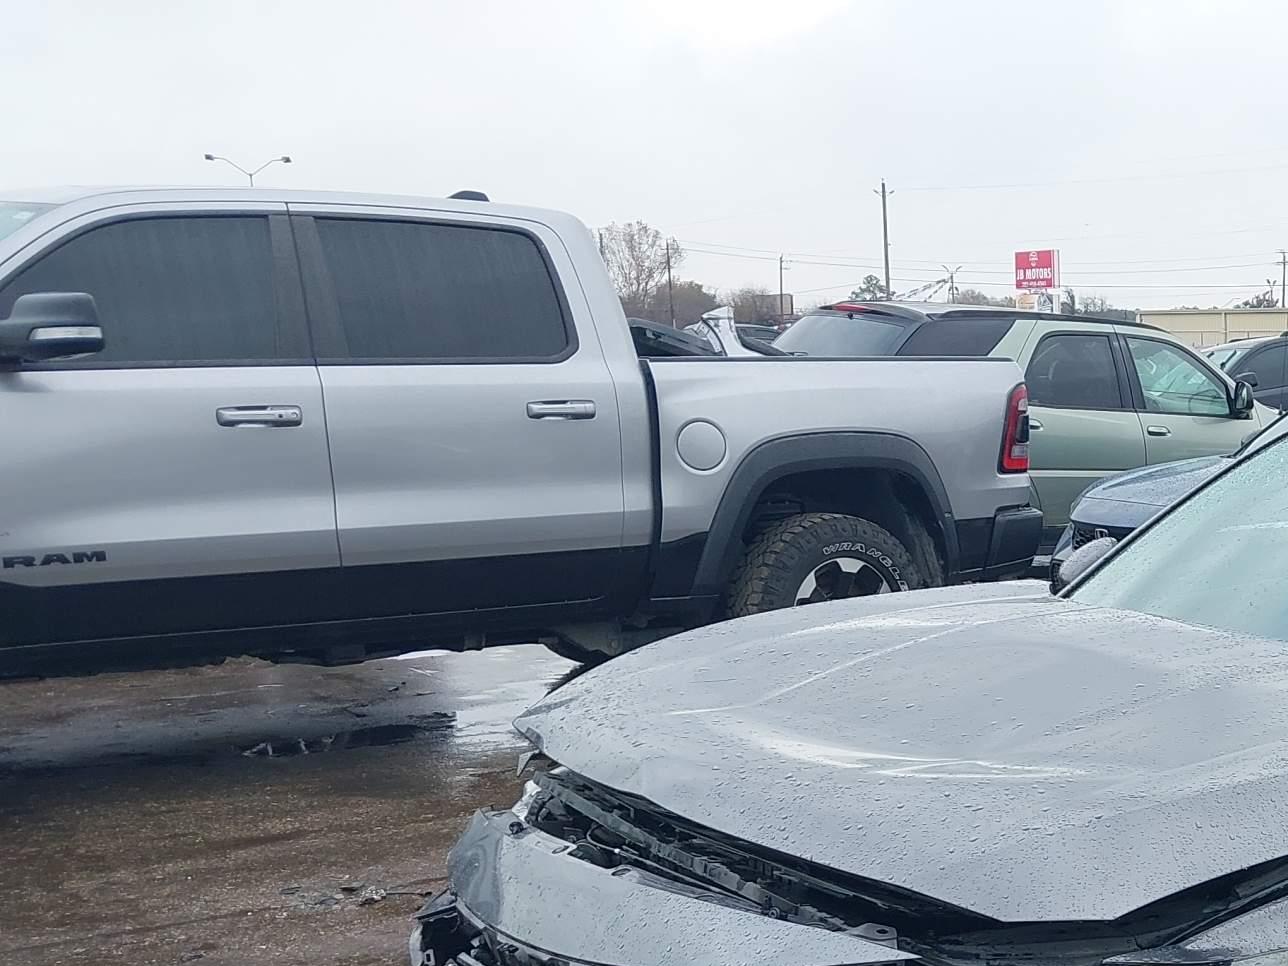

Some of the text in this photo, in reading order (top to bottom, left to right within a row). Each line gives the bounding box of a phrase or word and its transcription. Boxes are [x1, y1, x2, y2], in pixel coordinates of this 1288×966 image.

[1025, 268, 1052, 279] MOTORS
[2, 550, 107, 569] RAM
[823, 541, 909, 591] WRANGLE
